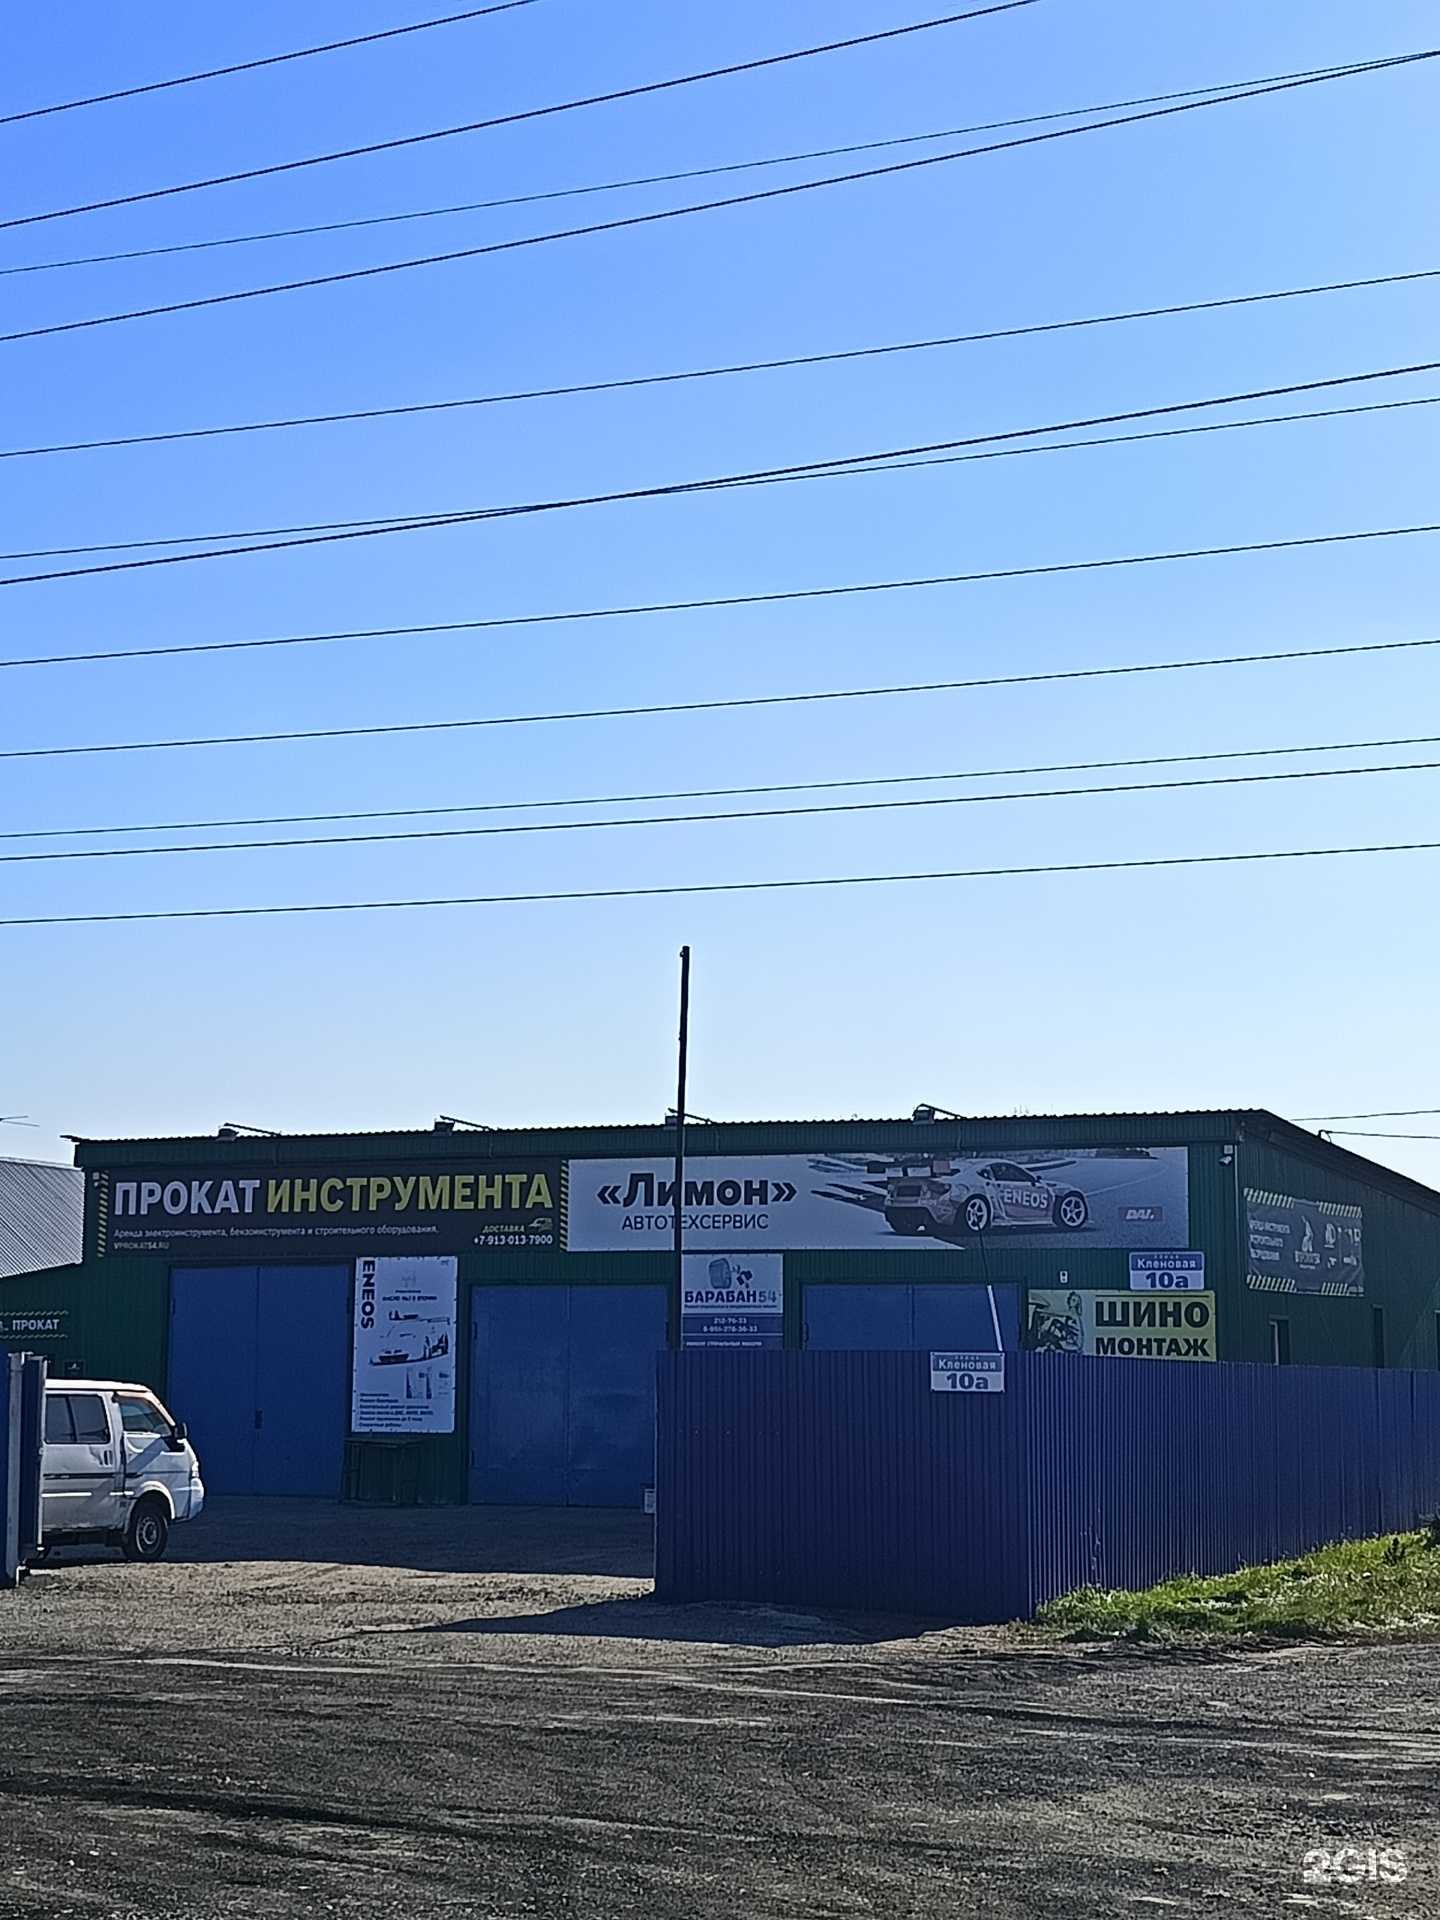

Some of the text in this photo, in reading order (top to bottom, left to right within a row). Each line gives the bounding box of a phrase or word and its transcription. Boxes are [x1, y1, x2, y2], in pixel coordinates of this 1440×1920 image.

[114, 1173, 554, 1215] ПРОКАТ ИНСТРУМЕНТА
[597, 1172, 797, 1208] «Лимон»
[1002, 1188, 1048, 1209] ENEOS
[621, 1213, 769, 1231] АВТОТЕХСЕРВИС
[1136, 1258, 1197, 1269] Кленовая
[1145, 1271, 1189, 1289] 10а
[361, 1259, 375, 1329] ENEOS
[1095, 1301, 1210, 1328] ШИНО
[12, 1319, 60, 1331] ПРОКАТ
[1095, 1337, 1210, 1357] МОНТАЖ
[938, 1359, 996, 1370] Кленовая
[946, 1372, 989, 1390] 10а
